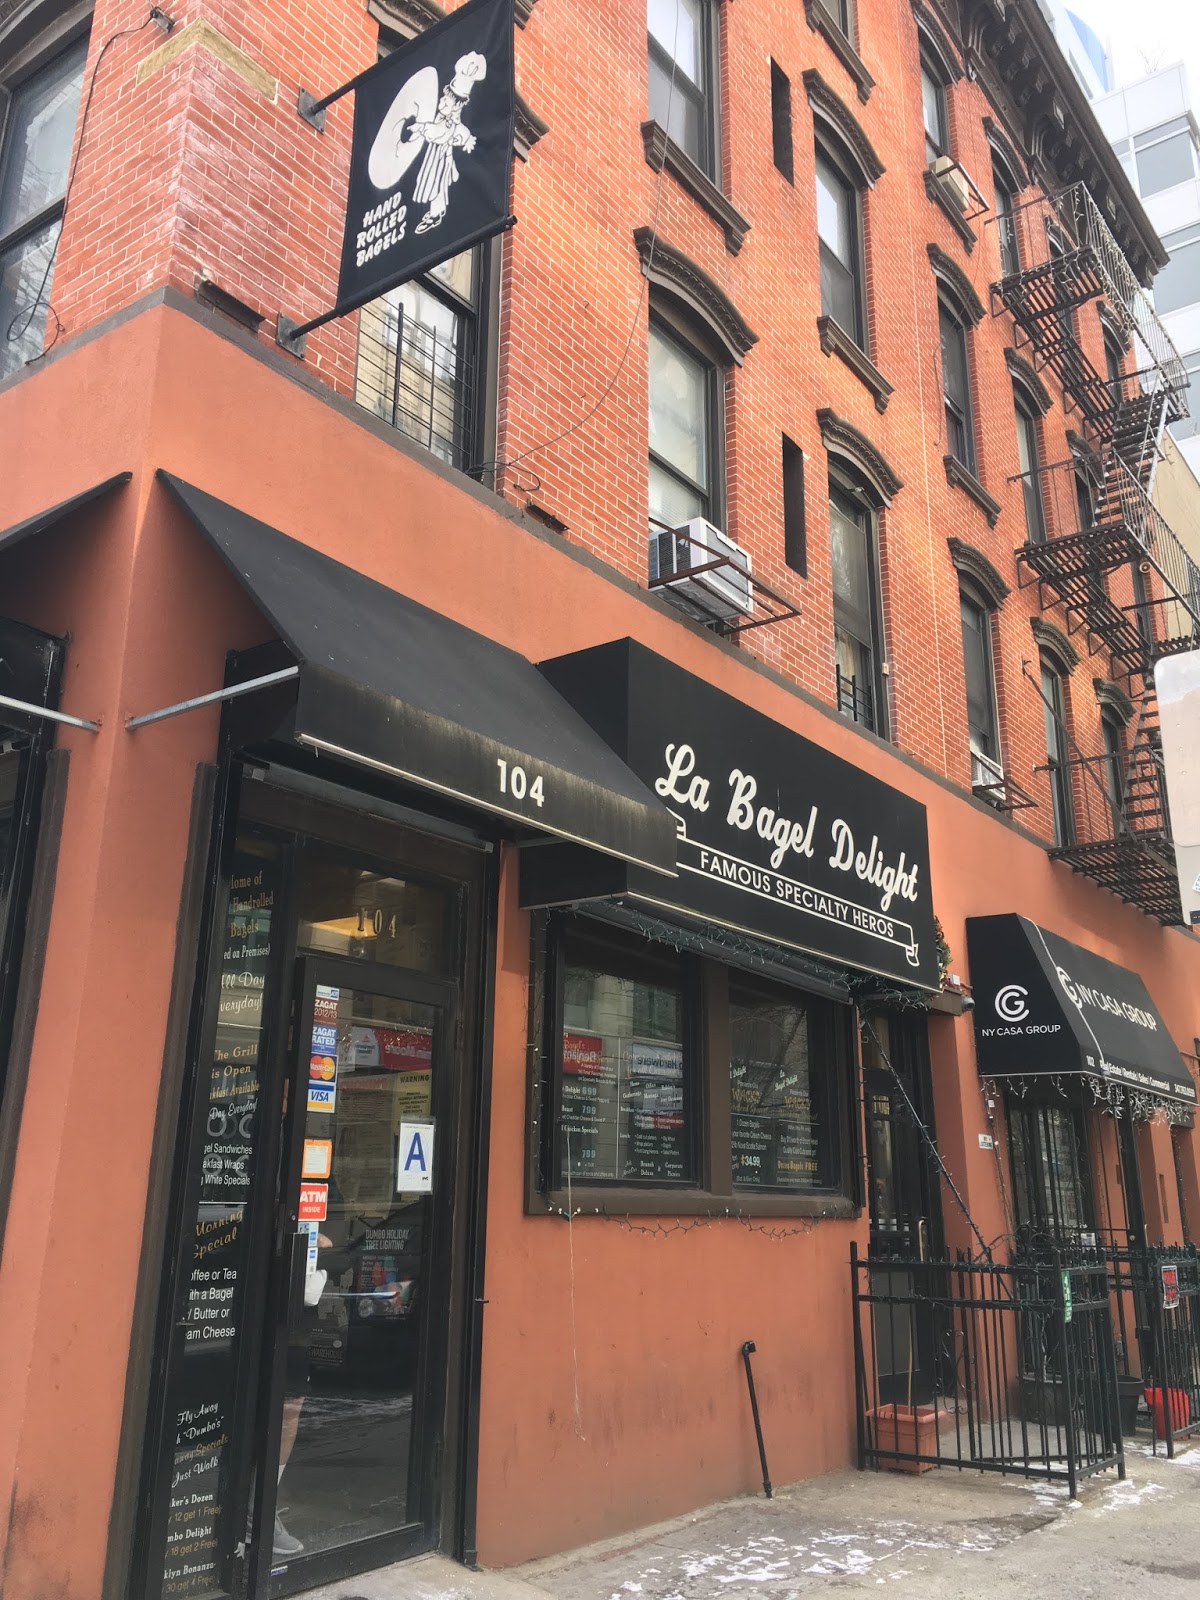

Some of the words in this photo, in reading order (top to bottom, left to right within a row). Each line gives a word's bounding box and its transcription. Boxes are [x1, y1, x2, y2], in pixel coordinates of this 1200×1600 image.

[363, 191, 402, 228] HAND
[356, 205, 407, 249] ROLLED
[356, 221, 407, 267] BAGELS
[497, 758, 545, 807] 104
[654, 743, 710, 813] La
[726, 768, 817, 869] Bagel
[828, 818, 919, 912] Delight
[253, 870, 263, 885] of
[700, 850, 771, 893] FAMOUS
[776, 879, 849, 921] SPECIALTY
[852, 908, 894, 938] HEROS
[233, 891, 274, 912] Handrolled
[230, 919, 260, 938] Bagels
[357, 907, 397, 938] 104
[232, 951, 240, 959] on
[241, 943, 271, 957] Premises)
[238, 971, 265, 988] Day
[315, 999, 338, 1010] ZAGAT
[1075, 982, 1097, 1007] NY
[1092, 989, 1124, 1017] CASA
[1121, 1002, 1158, 1031] GROUP
[314, 1008, 338, 1019] 2012/13
[312, 1027, 337, 1037] ZAGAT
[982, 1029, 996, 1037] NY
[996, 1027, 1024, 1036] CASA
[1026, 1025, 1061, 1034] GROUP
[312, 1035, 336, 1046] RATED
[233, 1044, 258, 1057] Grill
[1086, 1055, 1095, 1067] 102
[211, 1069, 220, 1079] is
[224, 1065, 251, 1077] Open
[400, 1075, 429, 1083] WARNING
[231, 1080, 260, 1096] Available
[582, 1087, 597, 1095] 699
[311, 1091, 329, 1102] VISA
[209, 1107, 226, 1120] Day
[582, 1105, 597, 1115] 799
[582, 1126, 598, 1134] Specials
[214, 1143, 253, 1155] Sandwiches
[404, 1132, 426, 1171] A
[582, 1149, 596, 1158] 799
[202, 1158, 223, 1169] akfast
[224, 1159, 245, 1171] Wraps
[805, 1162, 818, 1171] FREE
[205, 1174, 222, 1185] White
[223, 1175, 251, 1187] Specials
[300, 1191, 326, 1203] ATM
[365, 1229, 386, 1239] DUMBO
[386, 1229, 410, 1239] HOLIDAY
[365, 1240, 379, 1250] TREE
[380, 1240, 405, 1250] LIGHTING
[211, 1270, 221, 1280] or
[223, 1268, 237, 1279] Tea
[201, 1291, 207, 1300] a
[209, 1287, 234, 1301] Bagel
[193, 1307, 219, 1320] Butter
[221, 1308, 230, 1318] or
[202, 1326, 236, 1339] Cheese
[177, 1410, 193, 1426] Fly
[194, 1403, 219, 1419] Away
[196, 1434, 229, 1456] Specials
[171, 1469, 191, 1488] Just
[193, 1456, 219, 1474] Walk
[191, 1494, 213, 1504] Dozen
[174, 1512, 182, 1522] 12
[183, 1510, 196, 1522] get
[186, 1526, 212, 1539] Delight
[171, 1546, 179, 1556] 18
[180, 1544, 192, 1556] get
[193, 1542, 199, 1551] 2
[164, 1568, 181, 1579] klyn
